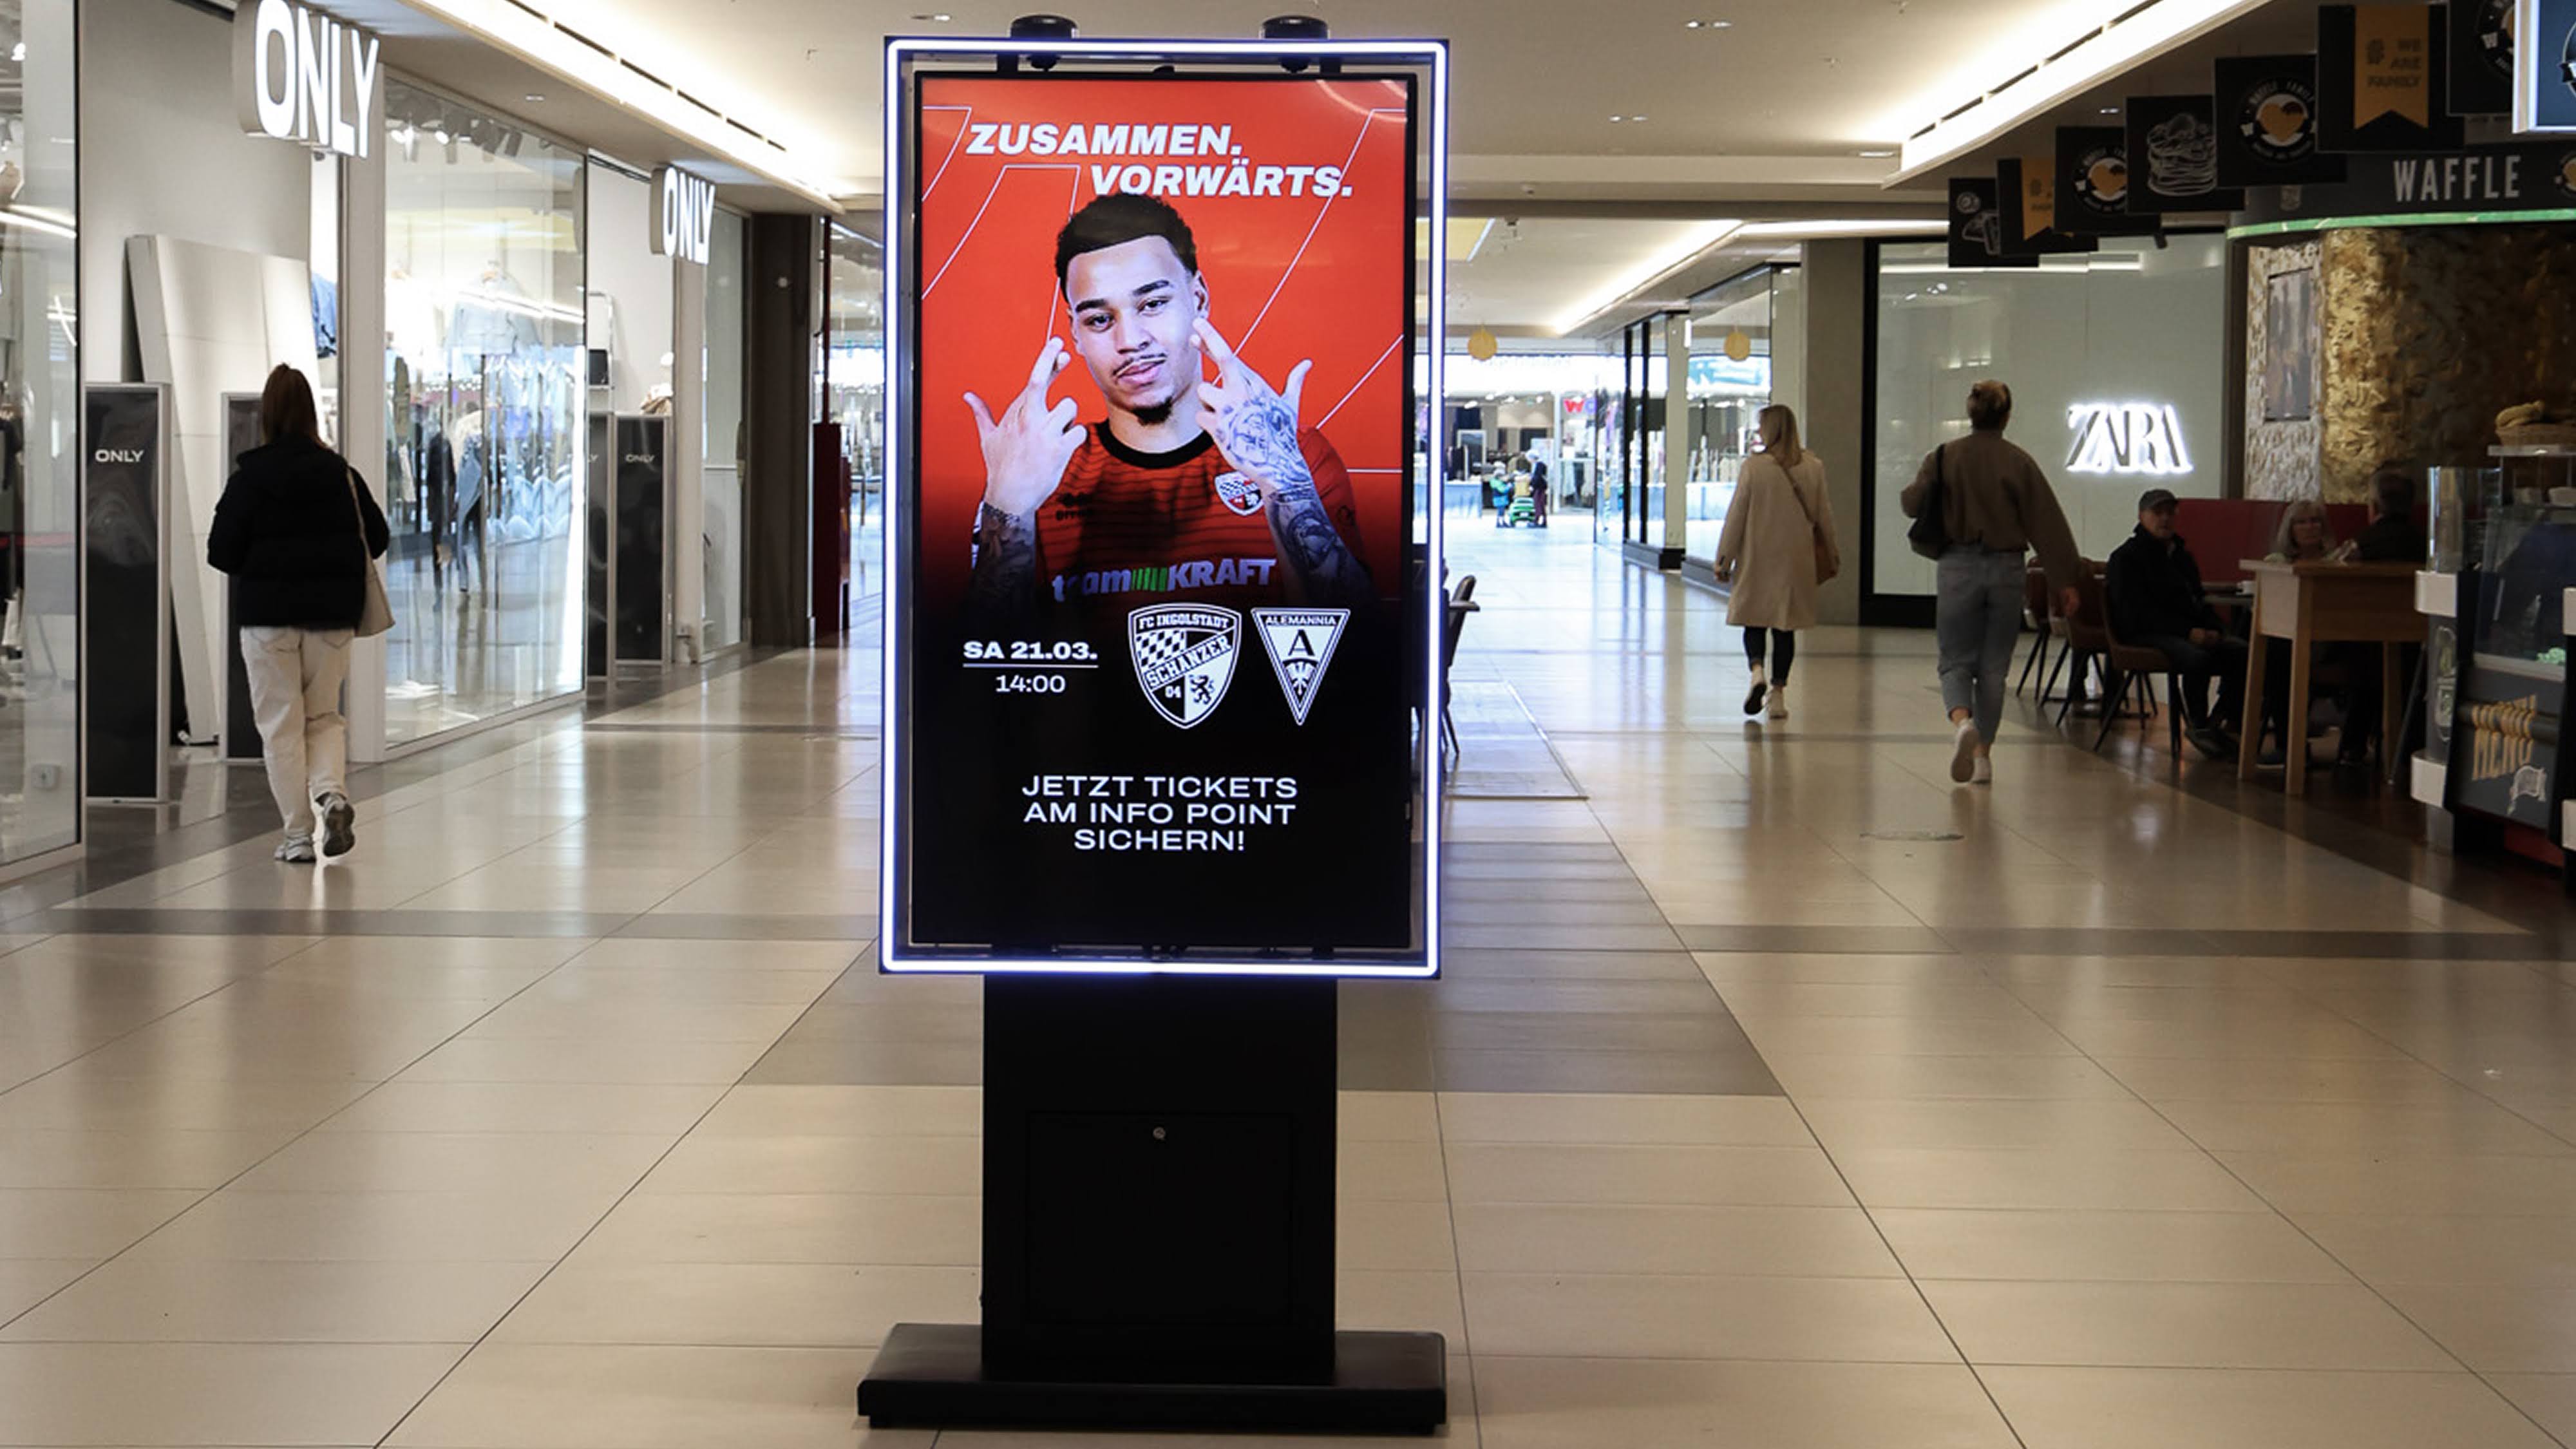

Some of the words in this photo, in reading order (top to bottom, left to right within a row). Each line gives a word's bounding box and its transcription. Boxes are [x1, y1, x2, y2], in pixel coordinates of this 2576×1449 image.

[256, 0, 379, 158] ONLY
[965, 123, 1243, 156] ZUSAMMEN.
[1091, 158, 1354, 197] VORWÄRTS.
[2393, 155, 2521, 202] WAFFLE
[663, 166, 715, 265] ONLY
[2066, 402, 2194, 474] ZARA
[95, 449, 144, 462] ONLY
[625, 453, 655, 464] ONLY
[1168, 558, 1276, 591] KRAFT
[1138, 616, 1155, 630] FC
[1156, 612, 1229, 628] INGOLSTADT
[1265, 616, 1336, 625] ALEMANNIA
[963, 641, 1004, 659] SA
[1010, 641, 1097, 659] 21.03.
[1288, 629, 1315, 656] A
[1145, 634, 1232, 687] SCHANZER
[996, 674, 1066, 694] 14:00
[1164, 685, 1182, 698] 04
[1022, 775, 1133, 798] JETZT
[1144, 776, 1298, 799] TICKETS
[1024, 802, 1076, 824] AM
[1090, 802, 1173, 824] INFO
[1187, 802, 1296, 825] POINT
[1074, 829, 1244, 851] SICHERN!
